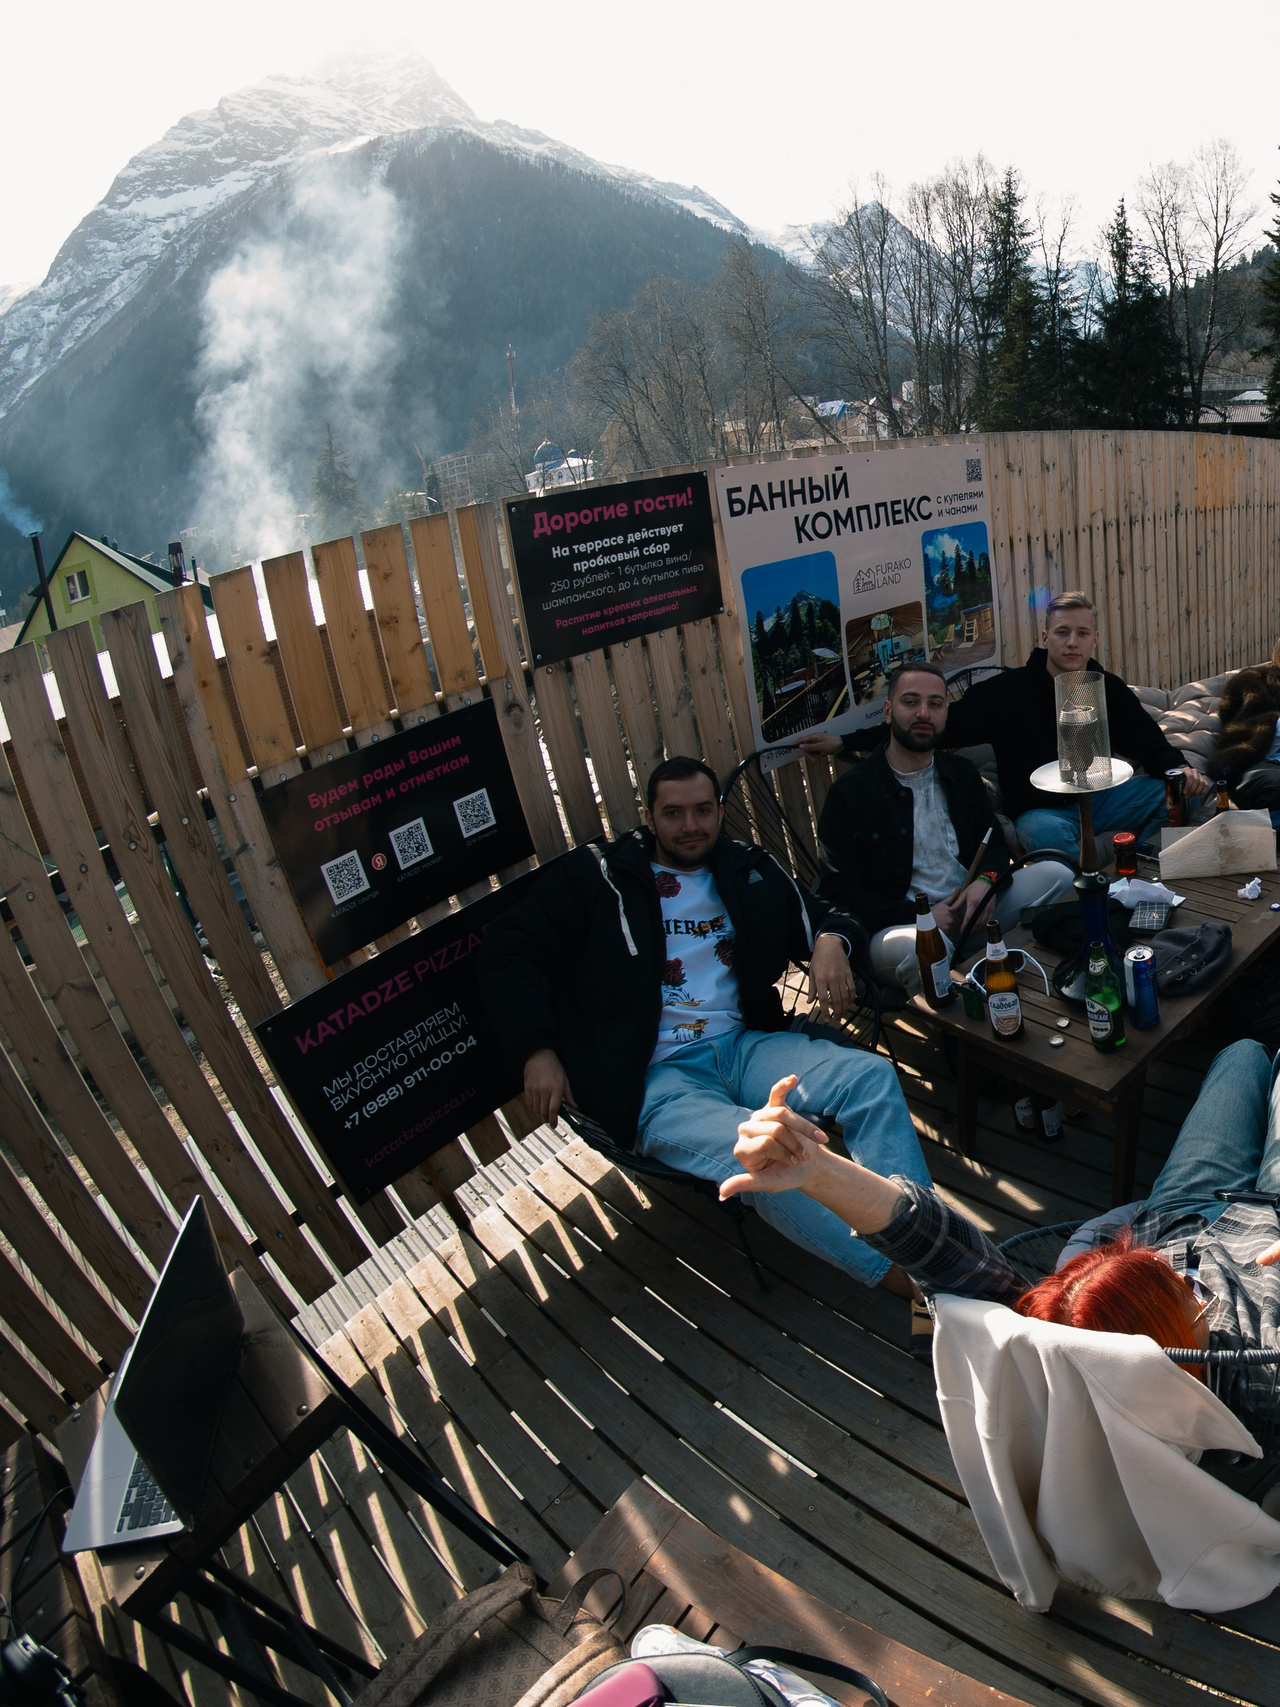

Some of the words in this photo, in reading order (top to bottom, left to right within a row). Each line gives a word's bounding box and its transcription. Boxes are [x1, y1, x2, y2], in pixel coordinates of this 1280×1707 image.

[533, 502, 628, 538] Дорогие
[634, 486, 694, 515] гости!
[726, 466, 850, 518] БАННЫЙ
[936, 497, 942, 505] с
[943, 489, 984, 505] купелями
[937, 509, 944, 517] и
[945, 503, 978, 516] чанами
[551, 545, 570, 559] На
[572, 535, 625, 556] террасе
[627, 522, 685, 544] действует
[794, 495, 933, 544] КОМПЛЕКС
[550, 578, 570, 593] 250
[617, 565, 623, 577] 1
[624, 558, 664, 575] бутылка
[665, 549, 693, 566] вина/
[572, 545, 640, 573] пробковый
[643, 540, 671, 557] сбор
[875, 557, 912, 578] FURAKO
[876, 570, 903, 587] LAND
[542, 583, 617, 611] шампанского,
[618, 580, 631, 593] до
[633, 575, 640, 586] 4
[642, 568, 681, 586] бутылок
[681, 561, 704, 576] пива
[555, 610, 602, 630] Распитие
[603, 600, 642, 617] крепких
[642, 584, 698, 606] алкогольных
[581, 617, 625, 636] напитков
[626, 601, 680, 624] запрещено!
[307, 779, 359, 809] Будем
[363, 761, 406, 789] рады
[408, 734, 462, 766] Вашим
[313, 793, 382, 832] отзывам
[385, 787, 396, 799] и
[399, 754, 471, 794] отметкам
[396, 866, 422, 883] KATADZE
[331, 899, 358, 919] KATADZE
[357, 889, 380, 906] Lounge
[294, 970, 415, 1055] KATADZE
[413, 933, 482, 982] PIZZA
[322, 1070, 353, 1098] МЫ
[354, 1001, 461, 1078] ДОСТАВЛЯЕМ
[330, 1053, 408, 1113] ВКУСНУЮ
[408, 1014, 470, 1058] ПИЦЦУ!
[343, 1112, 361, 1131] +7
[361, 1080, 405, 1122] (988)
[403, 1034, 478, 1090] 911-00-04
[364, 1084, 477, 1169] katadzepizza.ru
